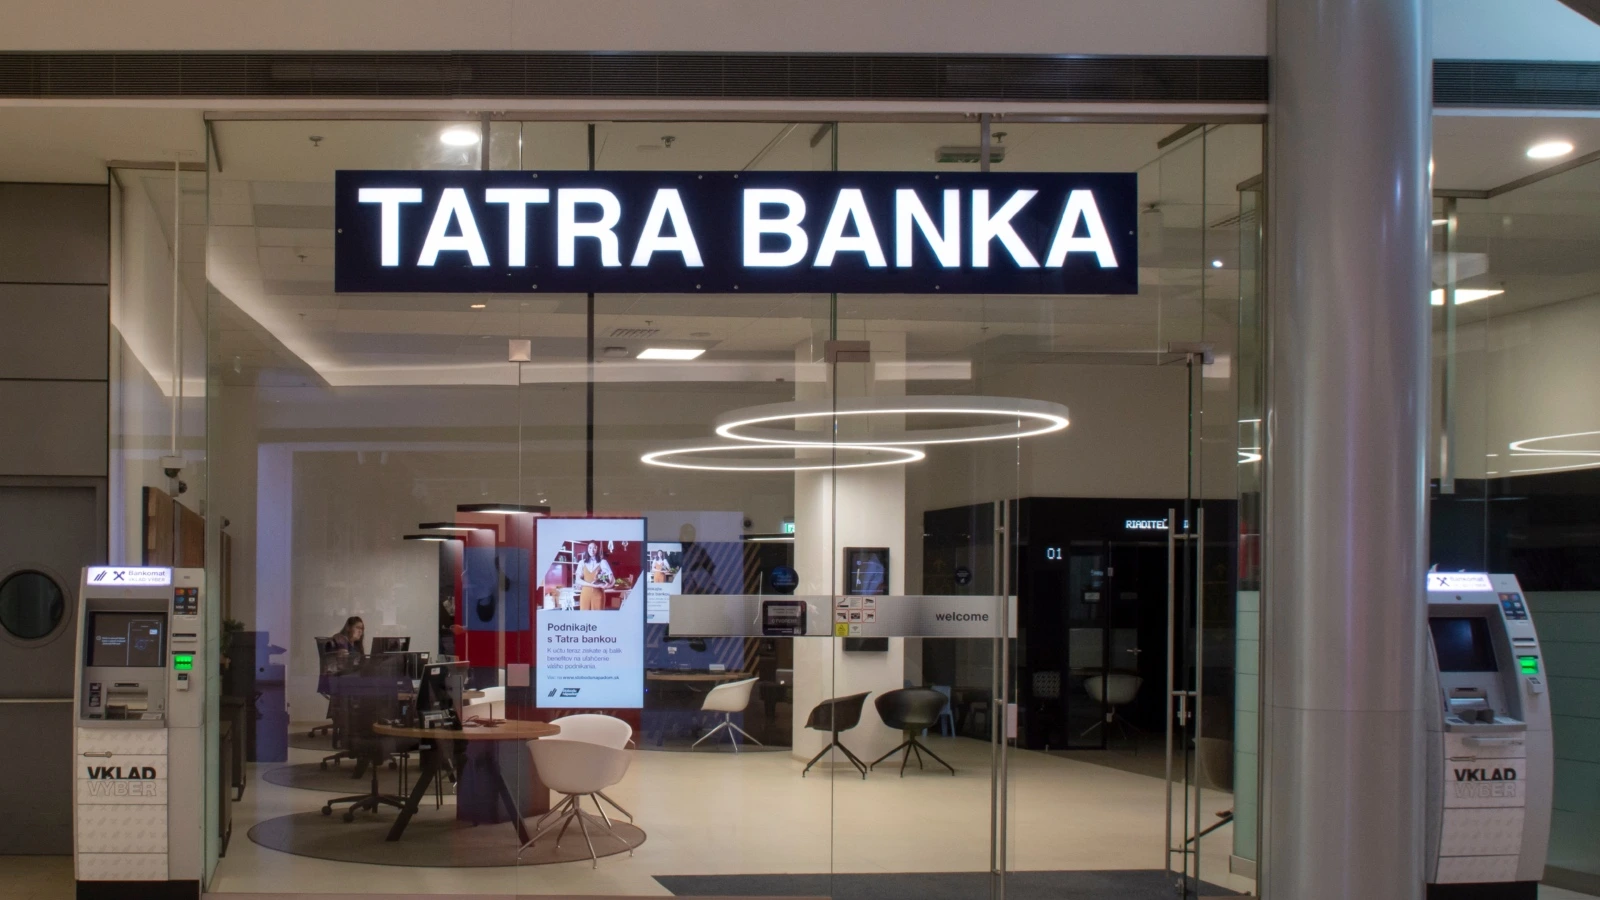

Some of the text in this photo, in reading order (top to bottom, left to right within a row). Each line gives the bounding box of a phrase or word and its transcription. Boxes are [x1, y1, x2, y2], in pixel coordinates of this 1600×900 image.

[358, 187, 1119, 268] TATRA BANKA
[1046, 547, 1063, 560] 01
[935, 611, 989, 622] welcome
[547, 623, 598, 633] Podnikajte
[555, 635, 579, 643] Tatra
[582, 635, 617, 643] bankou
[87, 766, 157, 780] VKLAD
[1454, 767, 1517, 781] VKLAD
